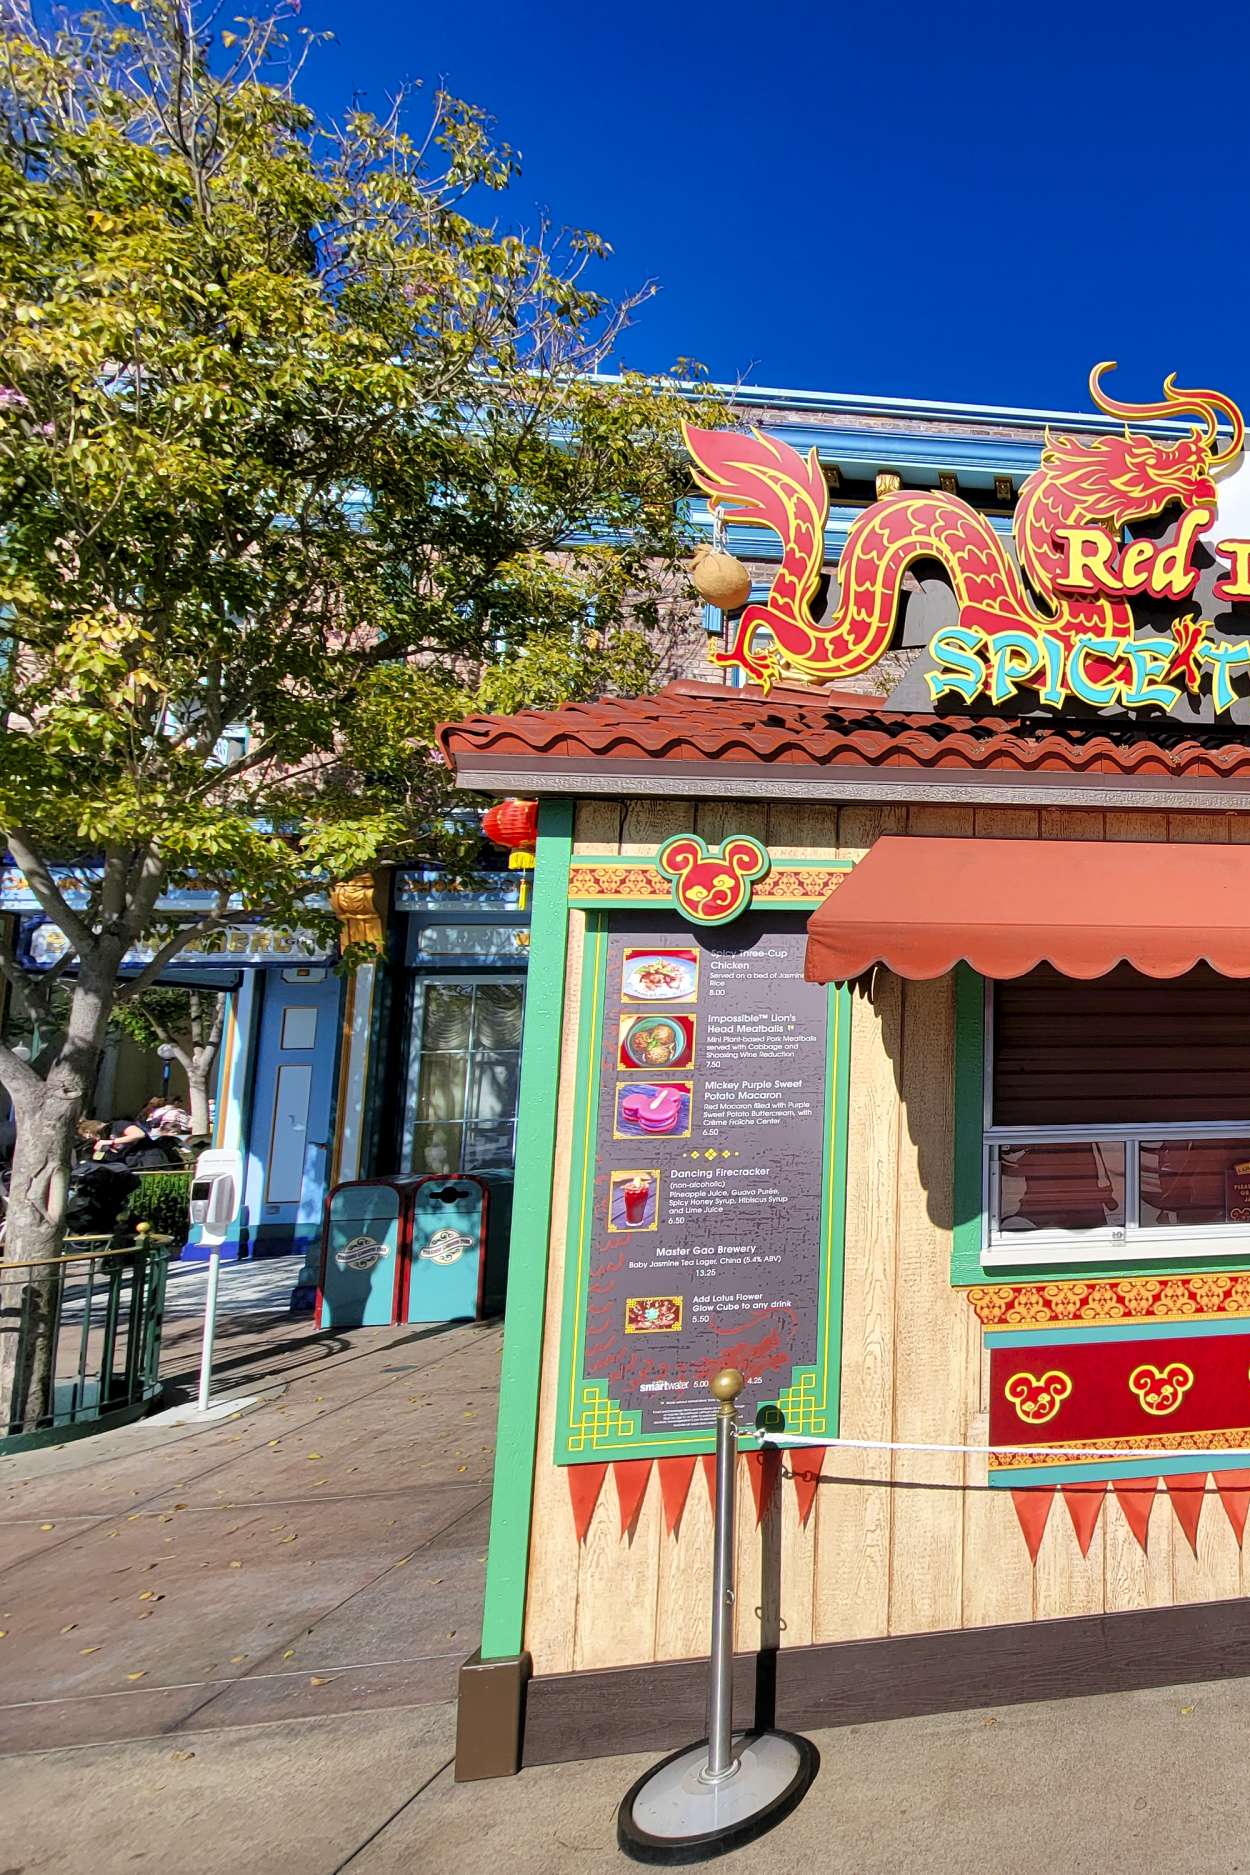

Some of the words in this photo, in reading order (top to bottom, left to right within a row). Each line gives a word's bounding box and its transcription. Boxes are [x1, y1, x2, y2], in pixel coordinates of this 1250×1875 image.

[1052, 507, 1214, 600] Red
[923, 626, 1183, 710] SPICE
[710, 961, 750, 969] Chicken
[771, 1014, 796, 1022] Lion's
[708, 1025, 734, 1033] Head
[736, 1025, 784, 1033] Meatballs
[705, 1081, 739, 1090] Mickey
[742, 1080, 772, 1090] Purple
[774, 1080, 802, 1088] Sweet
[704, 1092, 735, 1101] Potato
[738, 1091, 782, 1100] Macaron
[670, 1169, 713, 1179] Dancing
[715, 1168, 770, 1177] Firecracker
[670, 1181, 726, 1190] (non-alcoholic)
[669, 1199, 689, 1207] Spicy
[738, 1196, 767, 1204] Hibiscus
[668, 1217, 685, 1225] 6.50
[656, 1247, 690, 1257] Master
[693, 1246, 715, 1255] Gao
[717, 1245, 756, 1256] Brewery
[629, 1261, 647, 1269] Baby
[649, 1260, 679, 1268] Jasmine
[720, 1257, 742, 1265] China
[763, 1255, 782, 1263] ABV)
[695, 1269, 716, 1277] 13.25
[693, 1295, 710, 1303] Add
[712, 1294, 734, 1302] Lotus
[736, 1293, 763, 1301] Flower
[692, 1304, 714, 1312] Glow
[716, 1303, 739, 1311] Cube
[741, 1302, 750, 1310] to
[752, 1302, 769, 1311] any
[770, 1300, 792, 1308] drink
[691, 1315, 710, 1323] 5.50
[639, 1380, 689, 1392] smartwater
[693, 1380, 709, 1388] 5.00
[747, 1376, 763, 1385] 4.25
